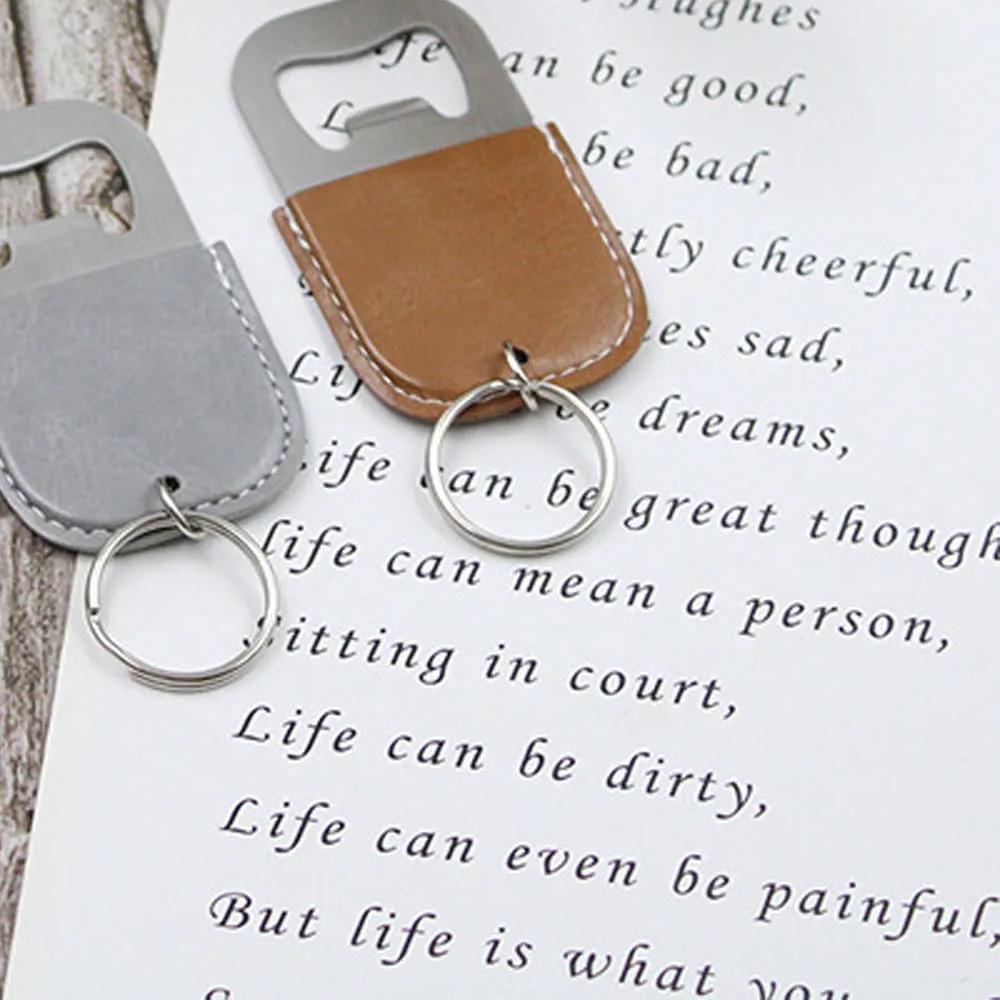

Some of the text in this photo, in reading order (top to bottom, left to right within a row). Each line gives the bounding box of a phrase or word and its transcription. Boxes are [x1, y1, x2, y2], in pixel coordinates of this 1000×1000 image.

[500, 50, 560, 78] an
[591, 48, 643, 90] be
[663, 72, 810, 116] good,
[581, 129, 773, 195] be bad,
[616, 223, 976, 302] tly cheerful,
[737, 326, 846, 373] sad,
[638, 394, 851, 460] dreams,
[300, 440, 391, 488] ife
[546, 468, 600, 512] be
[623, 492, 778, 531] great
[809, 504, 1000, 570] though
[386, 550, 482, 587] can
[512, 562, 656, 609] mean
[686, 592, 714, 617] a
[738, 592, 950, 653] person,
[484, 644, 539, 686] in
[569, 668, 738, 720] court,
[232, 705, 769, 820] Life can be dirty,
[220, 797, 346, 852] Life
[376, 824, 476, 864] can
[506, 844, 637, 887] even
[673, 854, 730, 901] be
[209, 891, 321, 939] But
[350, 906, 454, 966] life
[484, 926, 533, 970] is
[564, 944, 715, 997] what
